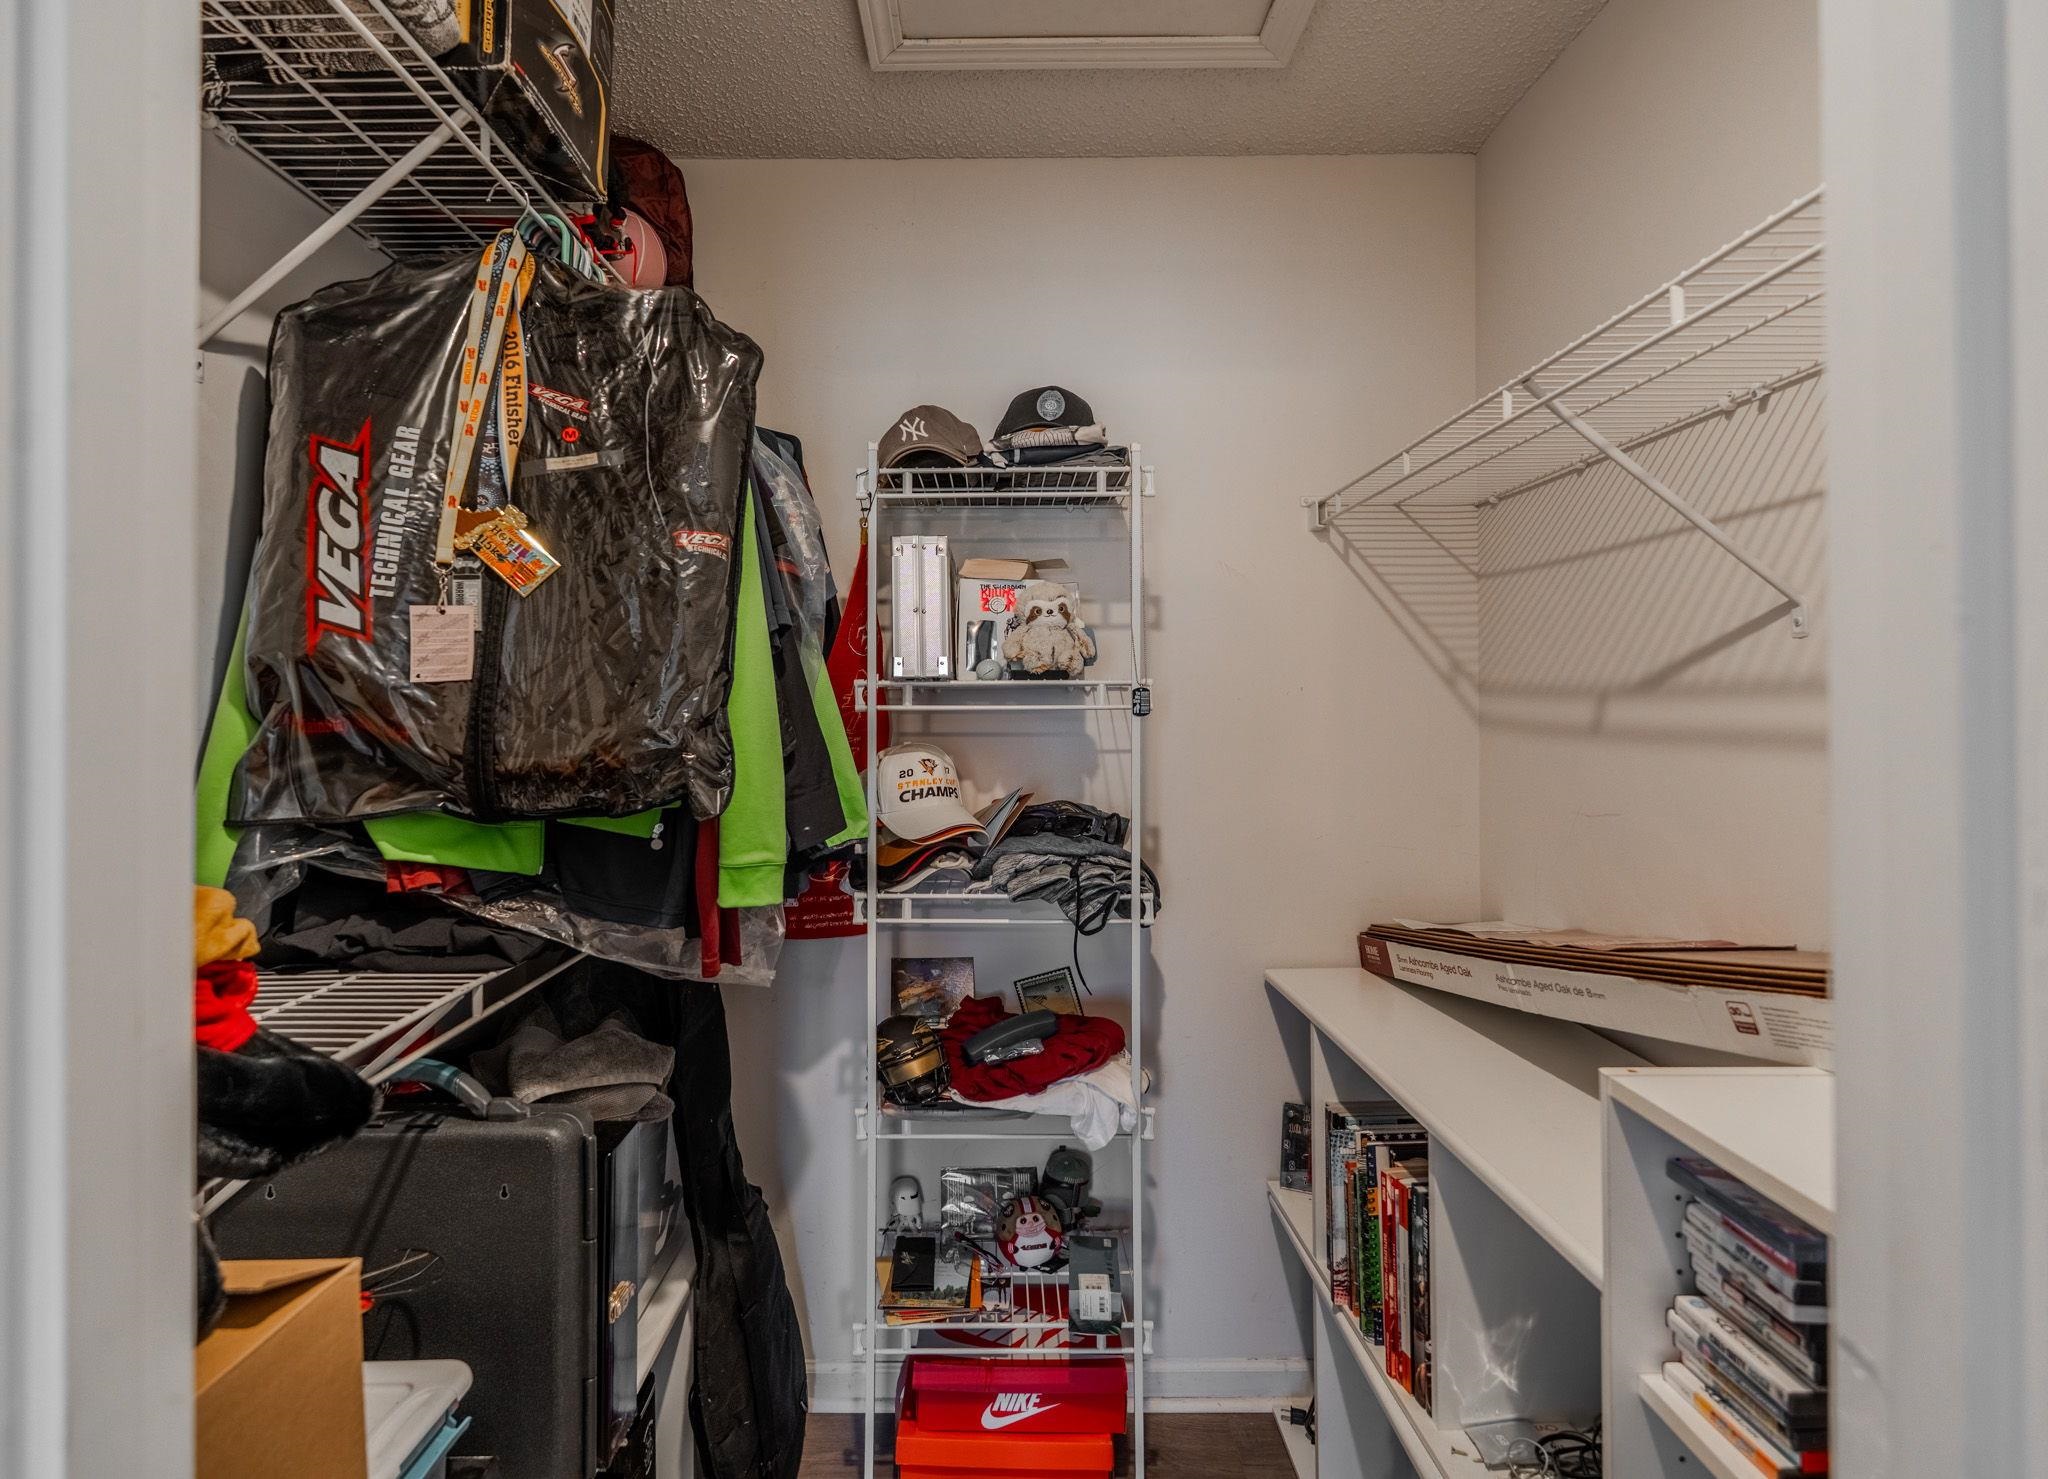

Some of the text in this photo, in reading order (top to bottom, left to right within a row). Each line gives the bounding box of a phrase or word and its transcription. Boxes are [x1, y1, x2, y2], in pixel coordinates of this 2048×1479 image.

[504, 330, 522, 448] 2016 Finisher
[531, 386, 585, 409] VEGA
[562, 431, 577, 439] M
[899, 416, 929, 442] NY
[368, 425, 421, 598] TECHNICAL GEAR
[317, 445, 361, 631] VEGA
[897, 777, 944, 790] STANLEY
[899, 768, 914, 779] 20
[899, 785, 959, 803] CHAMPS
[1408, 956, 1440, 971] Ashcombe
[1440, 962, 1458, 975] Aged
[1457, 965, 1473, 978] Oak
[1495, 973, 1532, 988] Ashcombe
[1533, 980, 1554, 992] Aged
[1554, 982, 1572, 995] Oak
[992, 1392, 1042, 1412] NIKE
